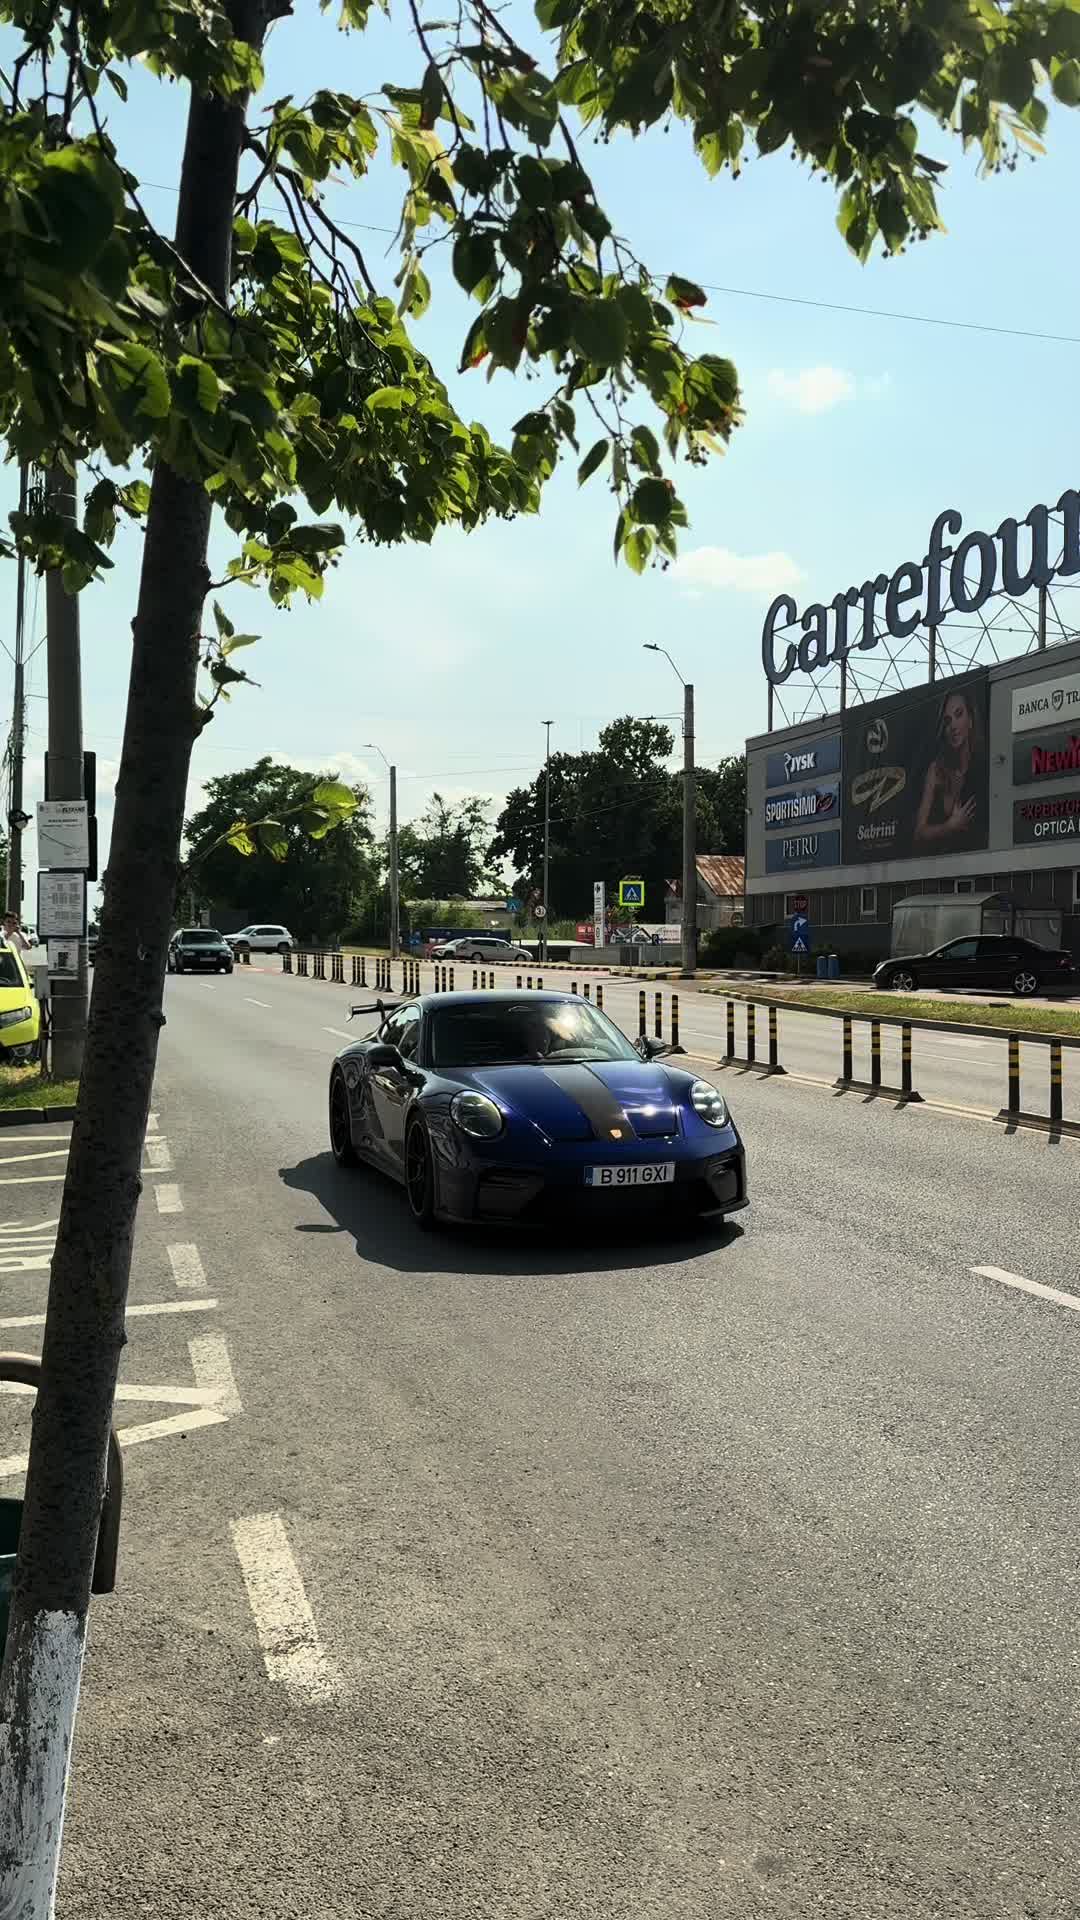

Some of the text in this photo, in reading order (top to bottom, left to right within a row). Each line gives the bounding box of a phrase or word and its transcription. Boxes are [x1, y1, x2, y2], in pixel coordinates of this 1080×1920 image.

[1019, 698, 1049, 715] BANCA
[1066, 689, 1080, 704] TR
[790, 752, 815, 773] JYSK
[766, 795, 817, 822] SPORTISIMO
[857, 821, 896, 840] Sabrini
[1034, 816, 1075, 836] OPTICĂ
[783, 835, 817, 857] PETRU
[601, 1166, 667, 1184] B 911 GXI
